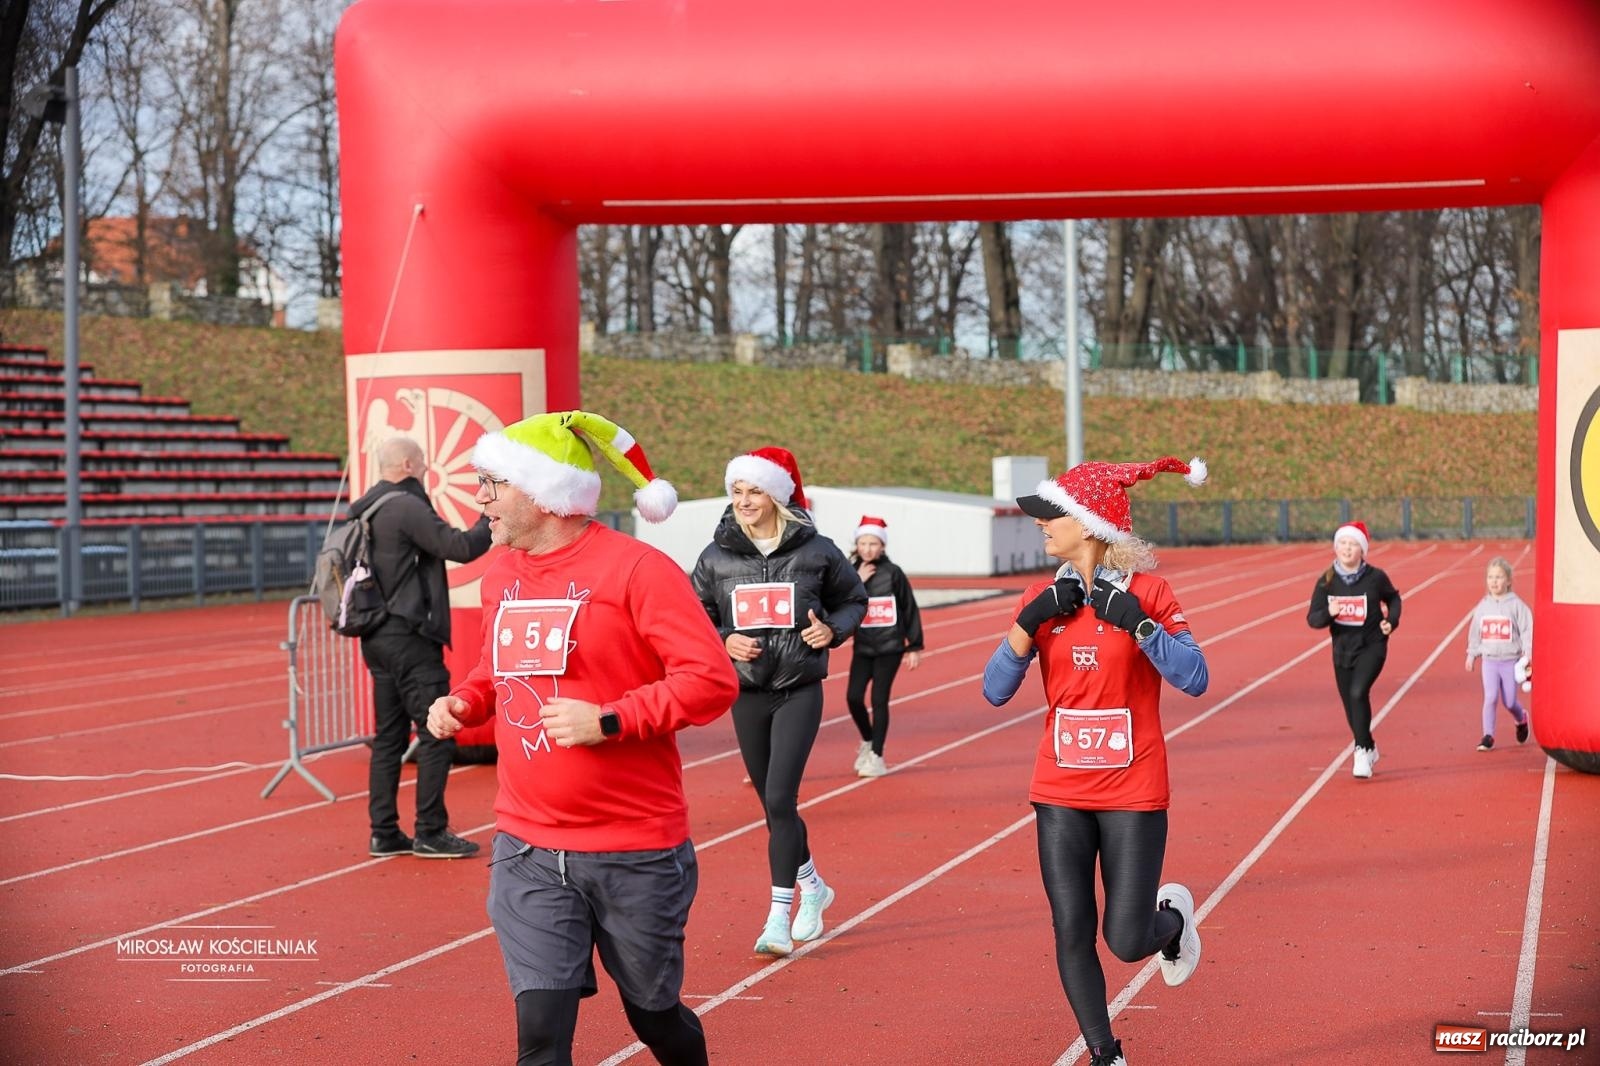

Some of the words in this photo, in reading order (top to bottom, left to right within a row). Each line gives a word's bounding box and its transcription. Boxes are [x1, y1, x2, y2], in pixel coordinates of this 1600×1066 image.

[758, 596, 768, 613] 1
[525, 621, 541, 650] 5
[1077, 728, 1106, 750] 57
